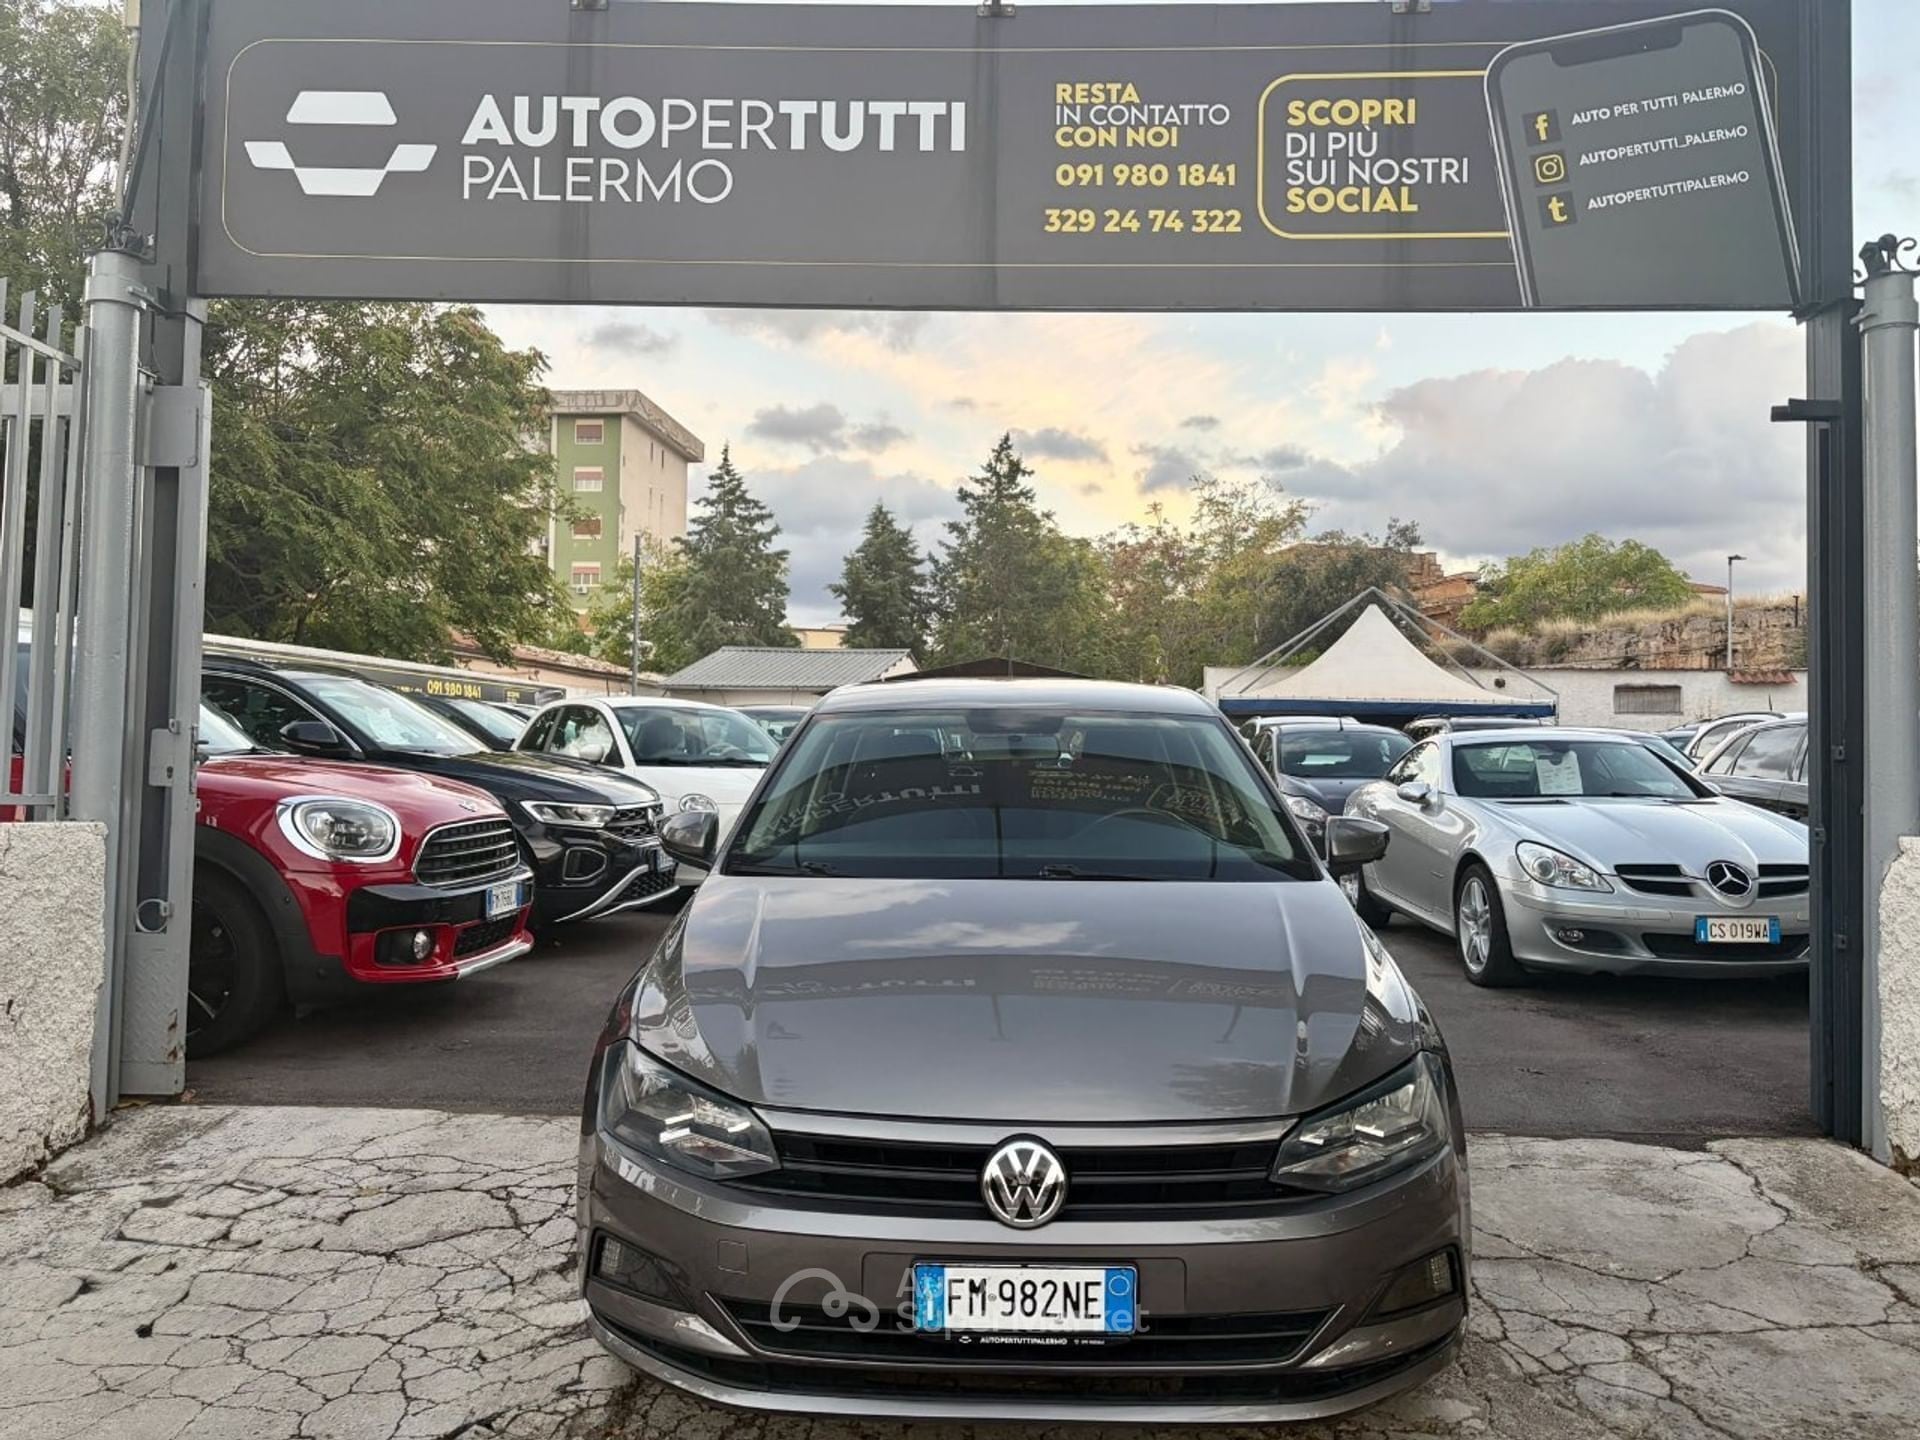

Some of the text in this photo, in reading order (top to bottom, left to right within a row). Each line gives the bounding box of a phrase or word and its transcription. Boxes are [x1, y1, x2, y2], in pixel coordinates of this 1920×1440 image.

[1055, 82, 1141, 105] RESTA
[1571, 107, 1611, 126] AUTO
[1613, 102, 1639, 118] PER
[1641, 95, 1679, 113] TUTTI
[1682, 82, 1746, 105] PALERMO
[460, 94, 966, 152] AUTOPERTUTTI
[1055, 103, 1230, 126] IN CONTATTO
[1286, 98, 1417, 127] SCOPRI
[1054, 126, 1178, 148] CON NOI
[1286, 125, 1378, 159] DI PIÙ
[1578, 124, 1749, 167] AUTOPERTUTTI_PALERMO
[462, 154, 733, 204] PALERMO
[1055, 163, 1236, 187] 091 980 1841
[1286, 156, 1469, 186] SUI NOSTRI
[1285, 186, 1420, 214] SOCIAL
[1586, 170, 1750, 211] AUTOPERTUTTIPALERMO
[1043, 208, 1242, 233] 329 24 74 322
[1709, 922, 1727, 939] CS
[947, 1278, 987, 1317] FM
[998, 1279, 1102, 1319] 982NE
